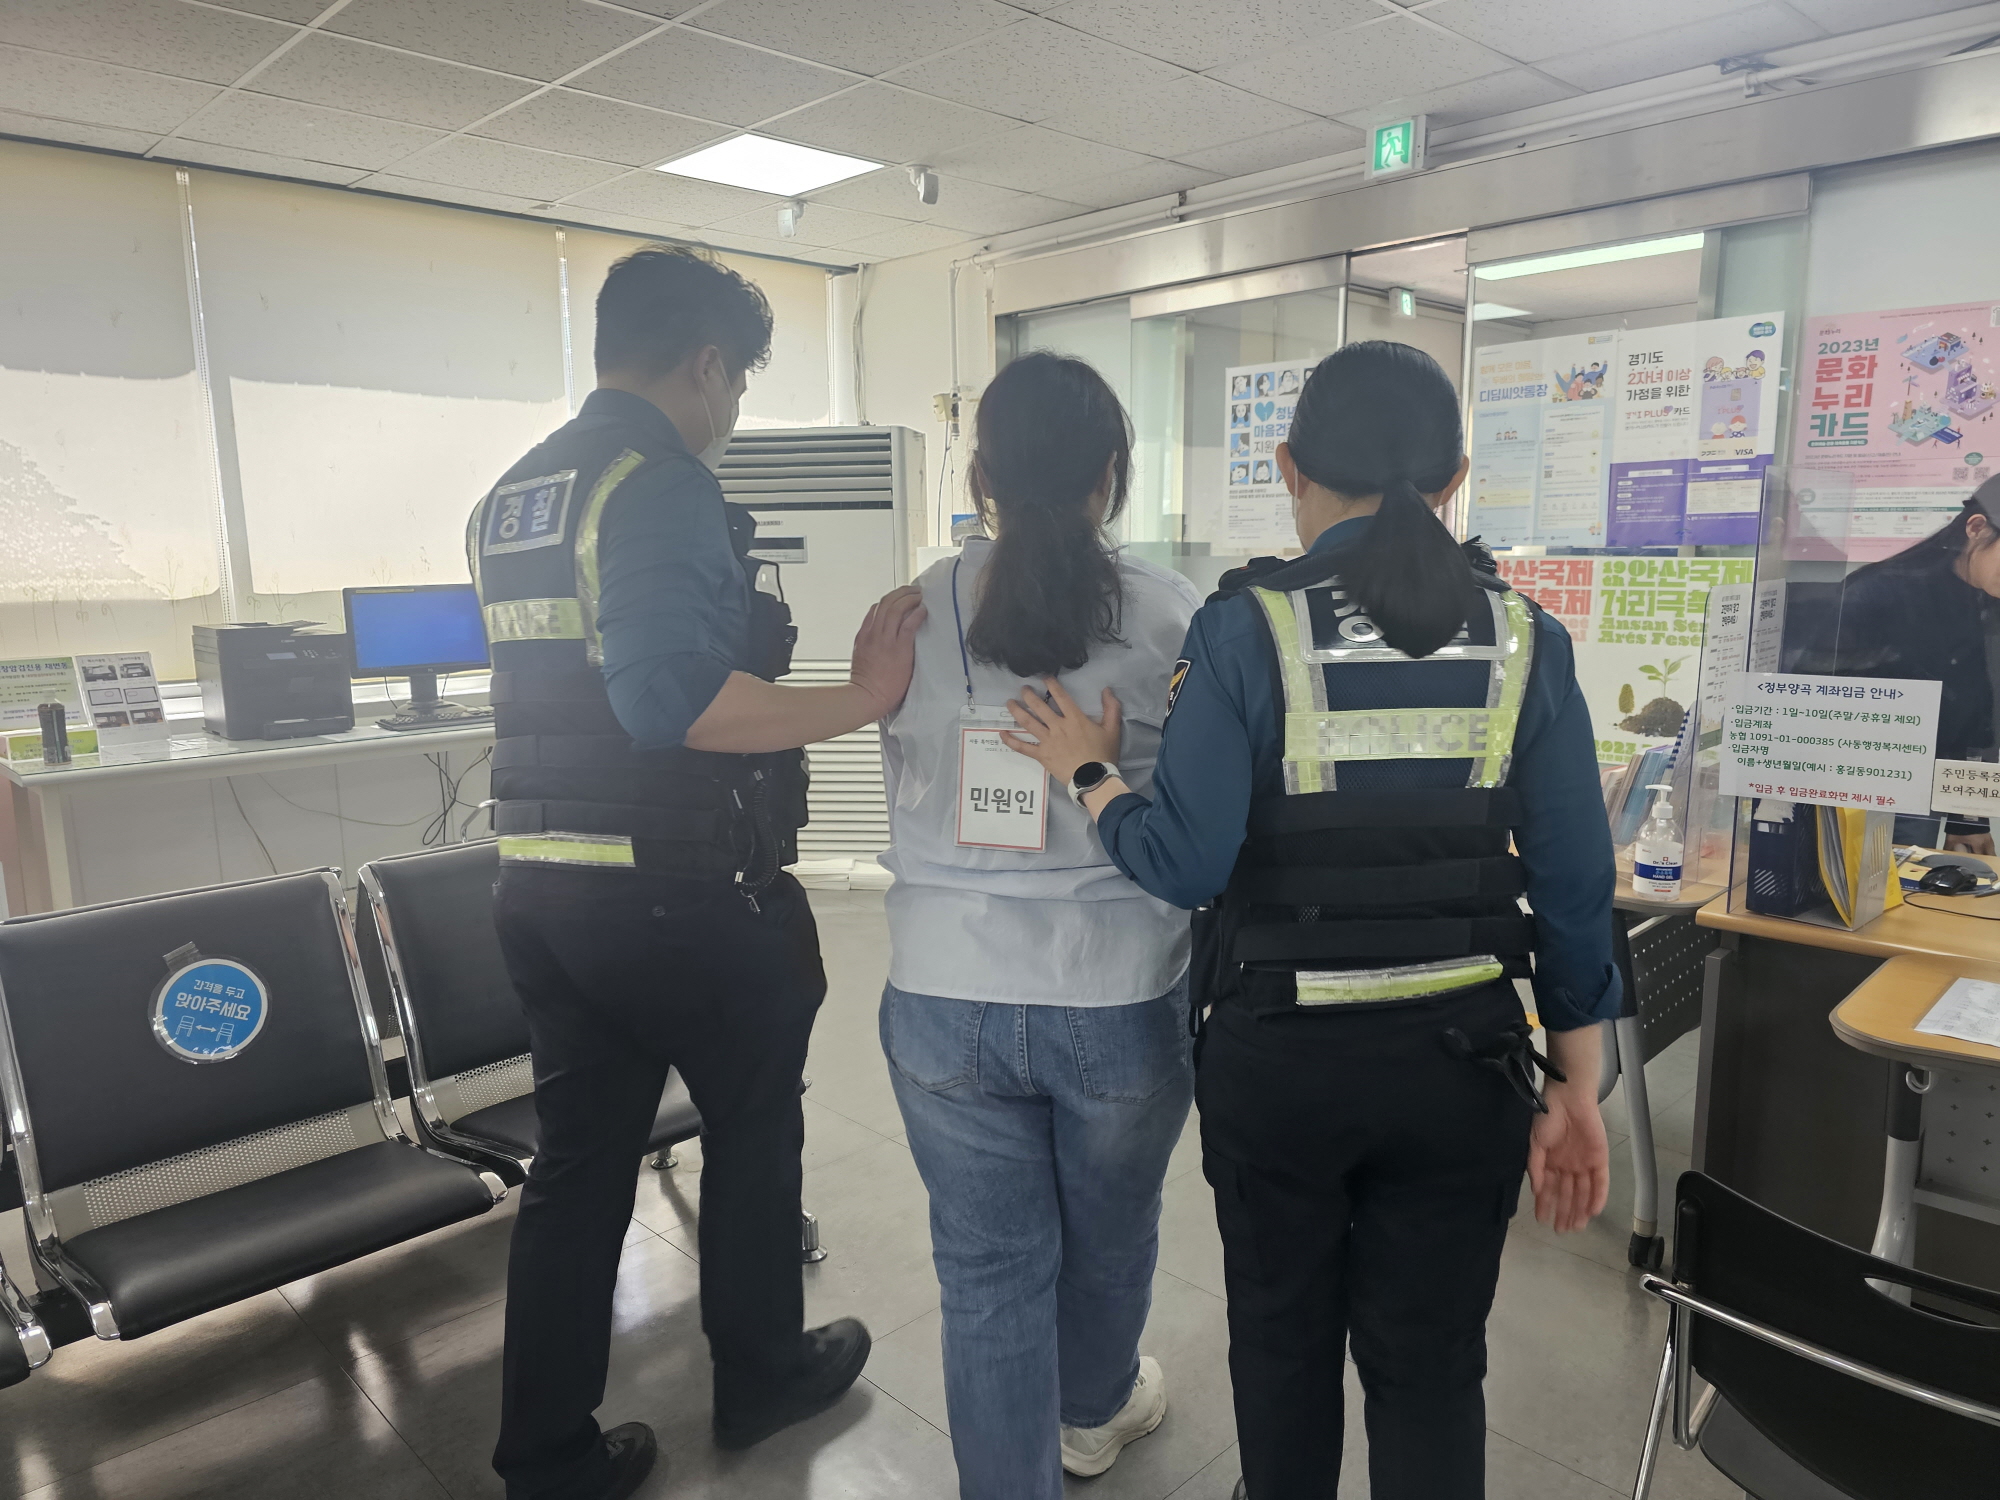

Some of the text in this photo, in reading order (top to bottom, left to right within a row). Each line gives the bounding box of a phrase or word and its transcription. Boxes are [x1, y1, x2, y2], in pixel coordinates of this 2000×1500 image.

[1818, 338, 1879, 355] 2023년
[1628, 351, 1664, 366] 경기도
[1627, 368, 1692, 385] 2자녀 이상
[1815, 354, 1878, 383] 문화
[1479, 383, 1549, 403] 디딤씨앗통장
[1626, 384, 1691, 401] 가정을 위한
[1812, 383, 1873, 410] 누리
[1644, 408, 1669, 418] PLUS
[1674, 406, 1690, 415] 카드
[1254, 422, 1292, 438] 마음건
[1810, 412, 1869, 437] 카드
[1254, 440, 1274, 453] 지원
[1603, 561, 1627, 574] 19
[1628, 560, 1754, 588] 안산국제
[1602, 575, 1625, 587] th
[1512, 588, 1592, 615] 축제
[1598, 617, 1668, 632] Ansan
[1598, 631, 1647, 645] Arts
[0, 663, 41, 673] 장암검진용
[1757, 682, 1904, 700] <정부양곡 계좌입금 안내>
[1782, 707, 1891, 724] 1일~10일(주말/공휴일
[1894, 714, 1921, 726] 제외)
[1729, 731, 1927, 755] 농협 1091-01-000385 (사동행정복지센터)
[1737, 757, 1826, 773] 이름+생년월일(예시
[1836, 764, 1913, 782] 홍길동901231)
[1942, 768, 2000, 783] 주민등록증
[1776, 786, 1786, 795] 후
[1789, 787, 1848, 802] 입금완료화면
[1852, 793, 1872, 803] 제시
[1875, 796, 1896, 806] 필수
[1940, 784, 2000, 798] 보여주세요
[970, 787, 1034, 815] 민원인
[193, 979, 245, 999] 간격을 두고
[175, 992, 251, 1021] 앉아주세요
